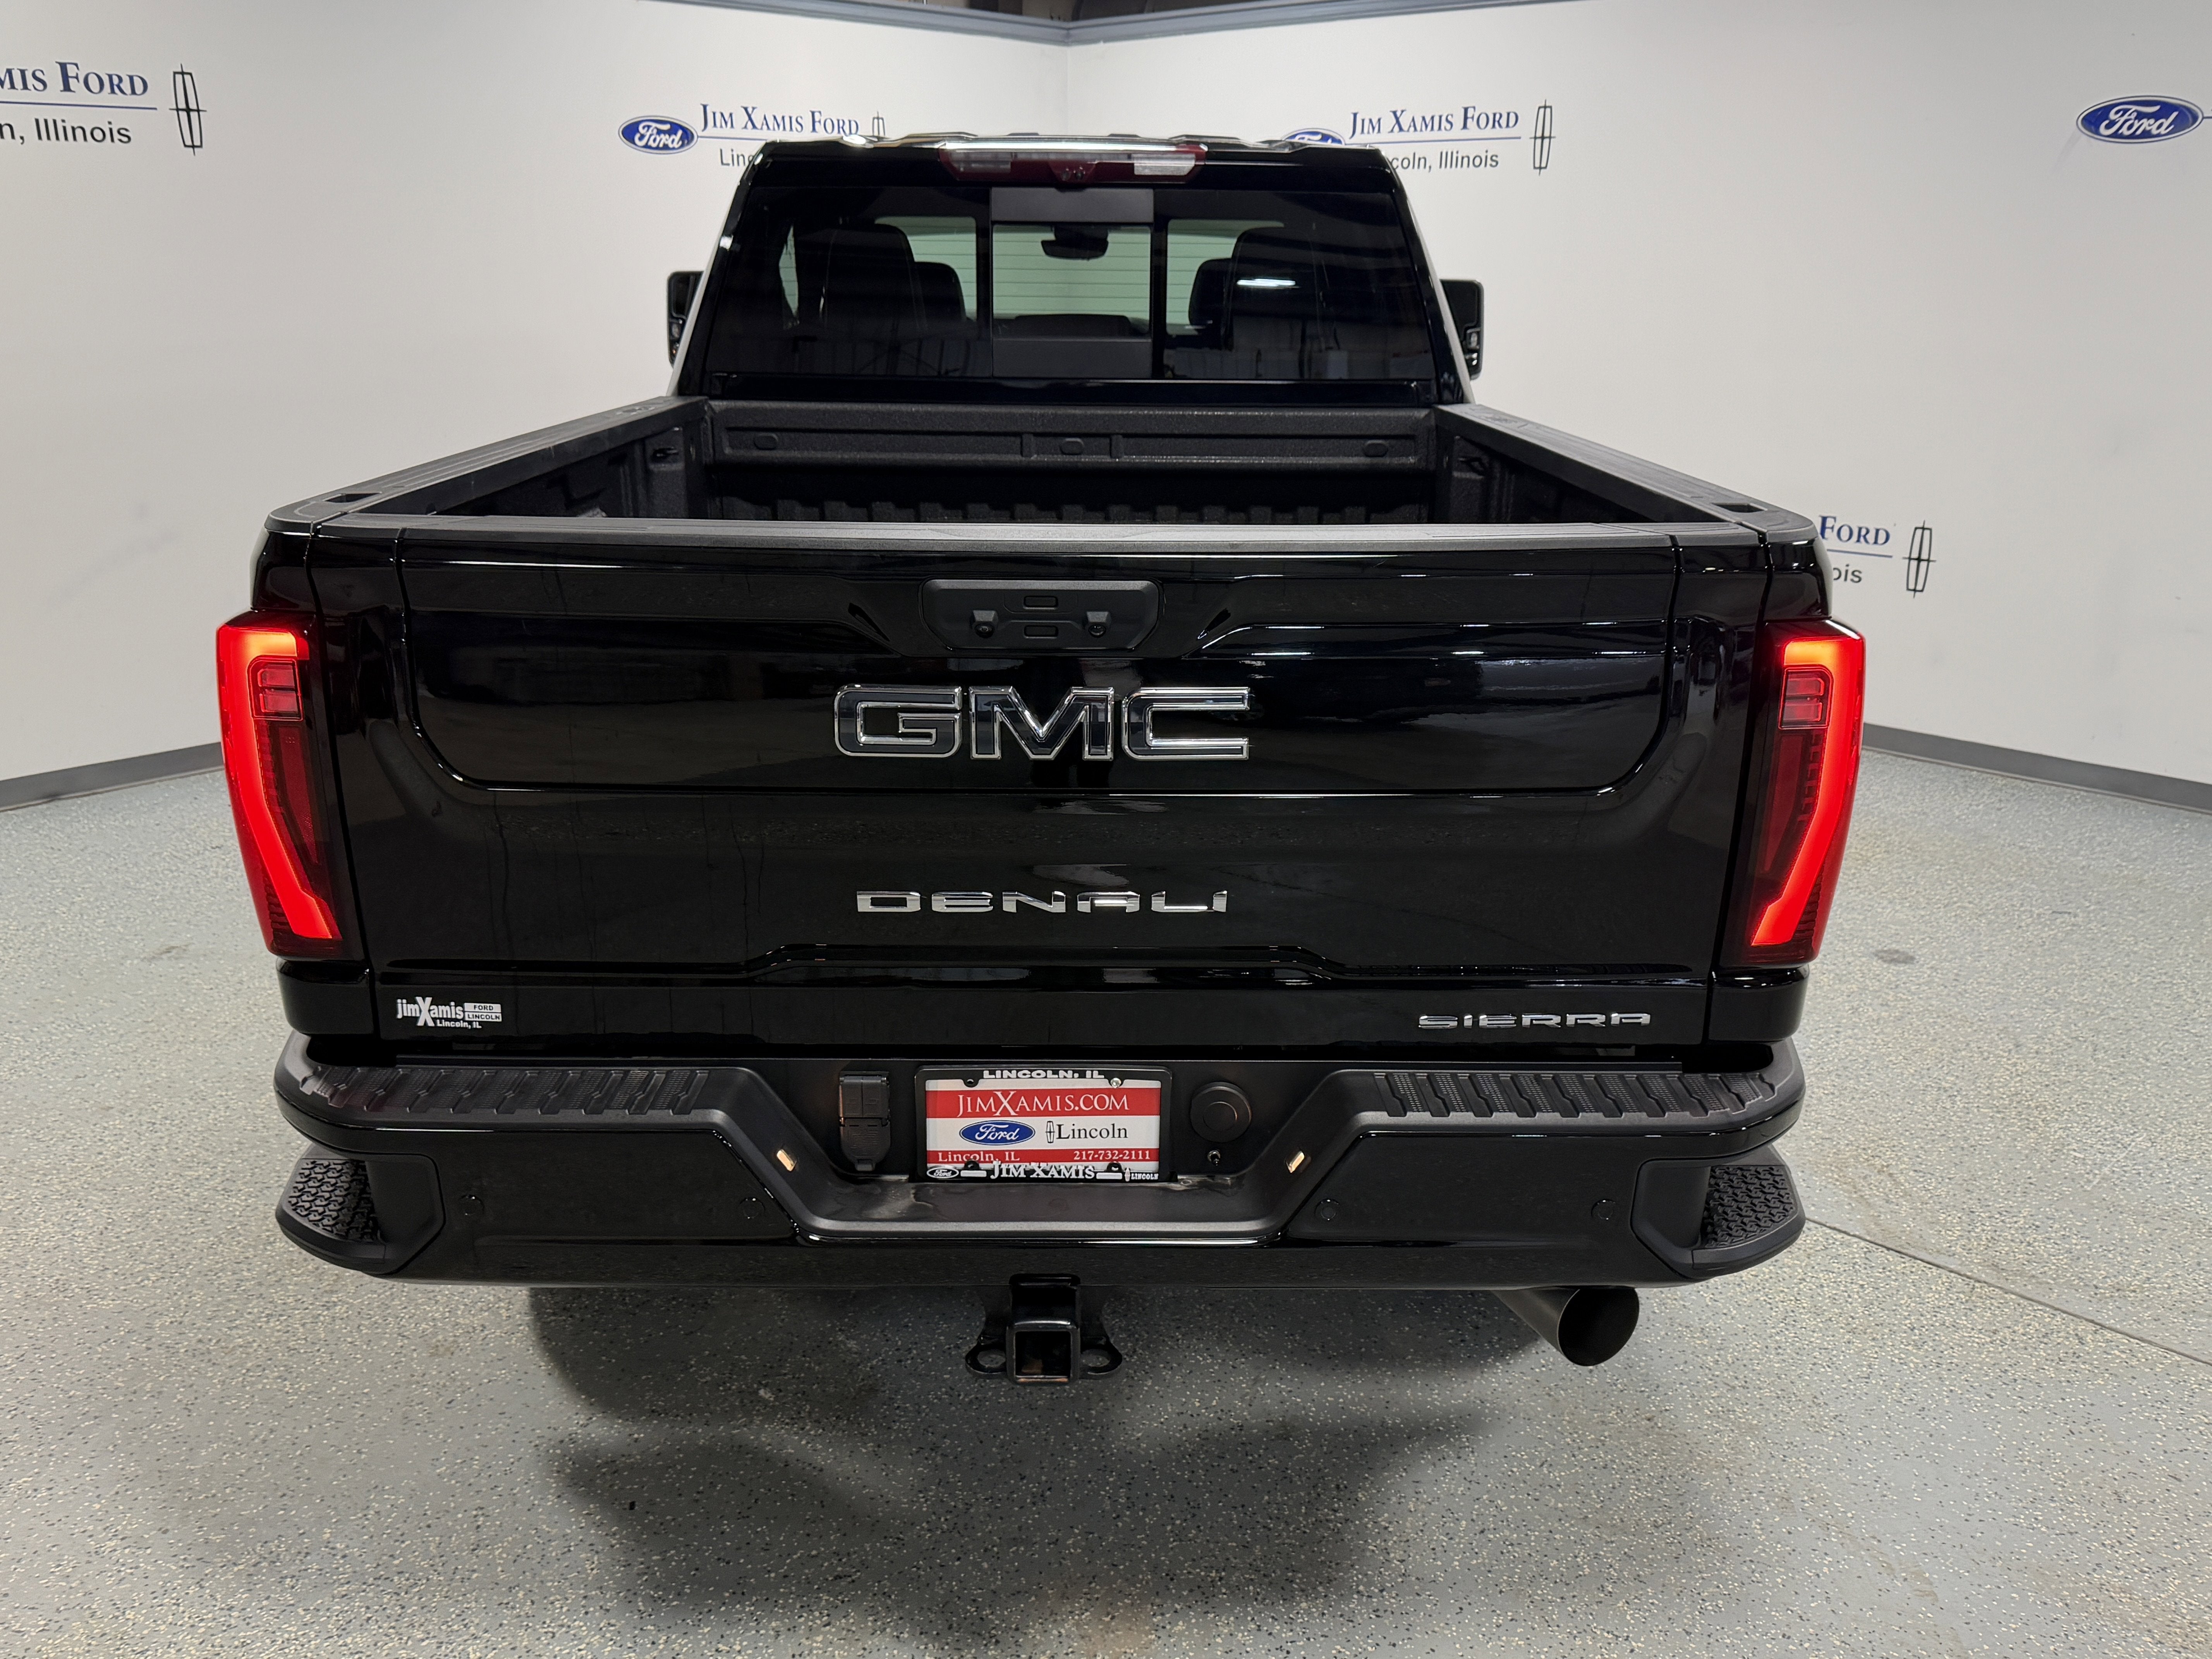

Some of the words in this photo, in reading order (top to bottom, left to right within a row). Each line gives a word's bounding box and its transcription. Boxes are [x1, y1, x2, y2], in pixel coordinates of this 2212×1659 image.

[55, 61, 148, 96] FORD
[700, 103, 734, 132] JIM
[741, 106, 804, 134] XAMIS
[810, 110, 859, 136] FORD
[1349, 112, 1382, 139] JIM
[1388, 109, 1454, 133] XAMIS
[1460, 105, 1519, 131] FORD
[2099, 105, 2179, 136] Ford
[34, 118, 132, 144] Illinois
[634, 122, 682, 149] Ford
[1439, 150, 1499, 169] Illinois
[1819, 515, 1890, 546] FORD
[834, 684, 1250, 761] GMC
[857, 891, 1227, 913] DENALI
[436, 1019, 471, 1029] Lincoln,
[1418, 1013, 1650, 1029] SIERRA
[1085, 1070, 1104, 1079] IL
[957, 1091, 1130, 1117] JIMXAMIS.COM
[975, 1124, 1019, 1140] Ford
[1056, 1123, 1128, 1139] Lincoln
[1005, 1152, 1020, 1161] IL
[1073, 1150, 1151, 1161] 217-732-2111
[990, 1160, 1026, 1179] JIM
[1030, 1162, 1095, 1179] XAMIS
